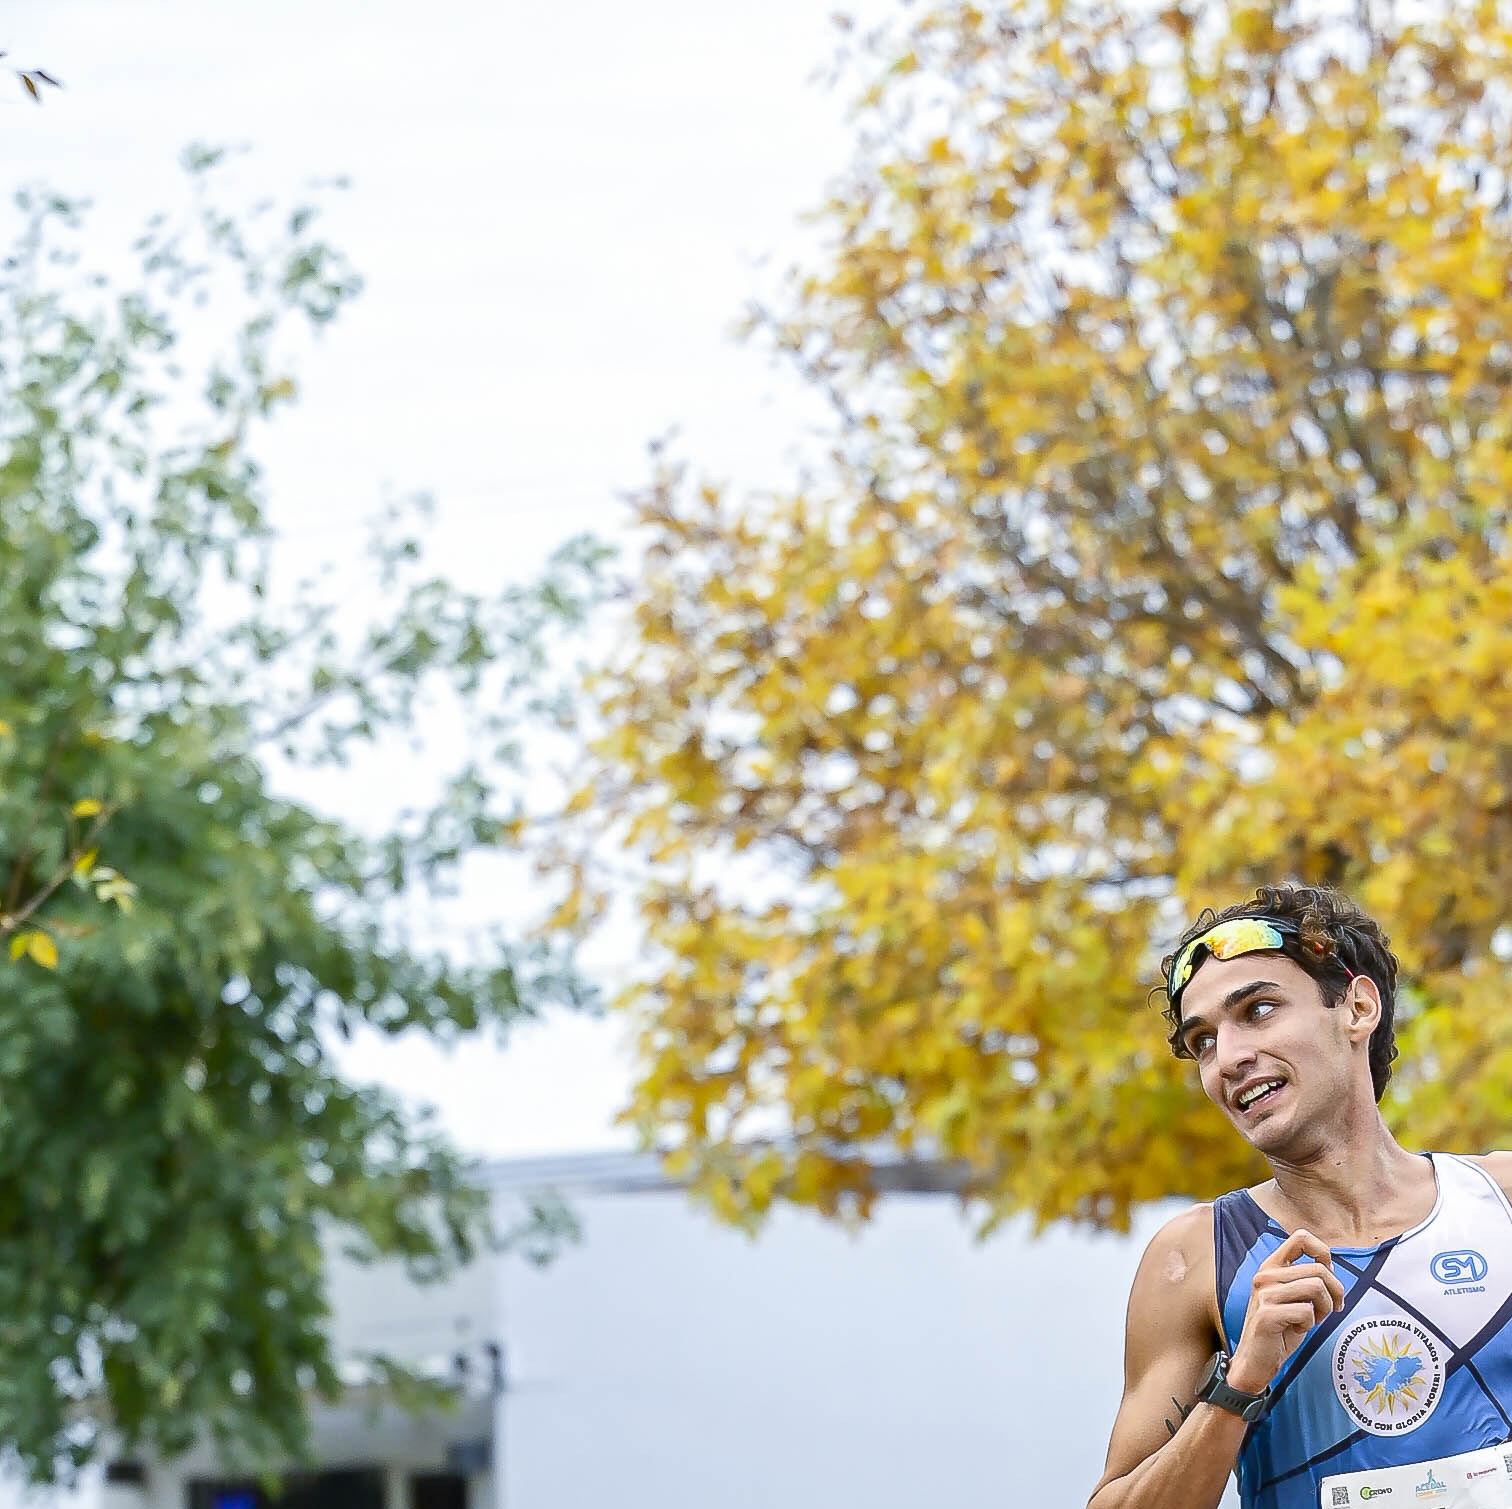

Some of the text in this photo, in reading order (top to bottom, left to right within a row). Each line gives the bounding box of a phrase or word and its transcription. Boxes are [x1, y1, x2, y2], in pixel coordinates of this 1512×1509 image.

[1443, 1285, 1486, 1296] ATLETISMO
[1337, 1319, 1439, 1372] CORONADOS DE GLORIA VIVAMOS
[1343, 1393, 1374, 1427] JUREMOS
[1374, 1422, 1393, 1431] CON
[1395, 1408, 1427, 1430] GLORIA
